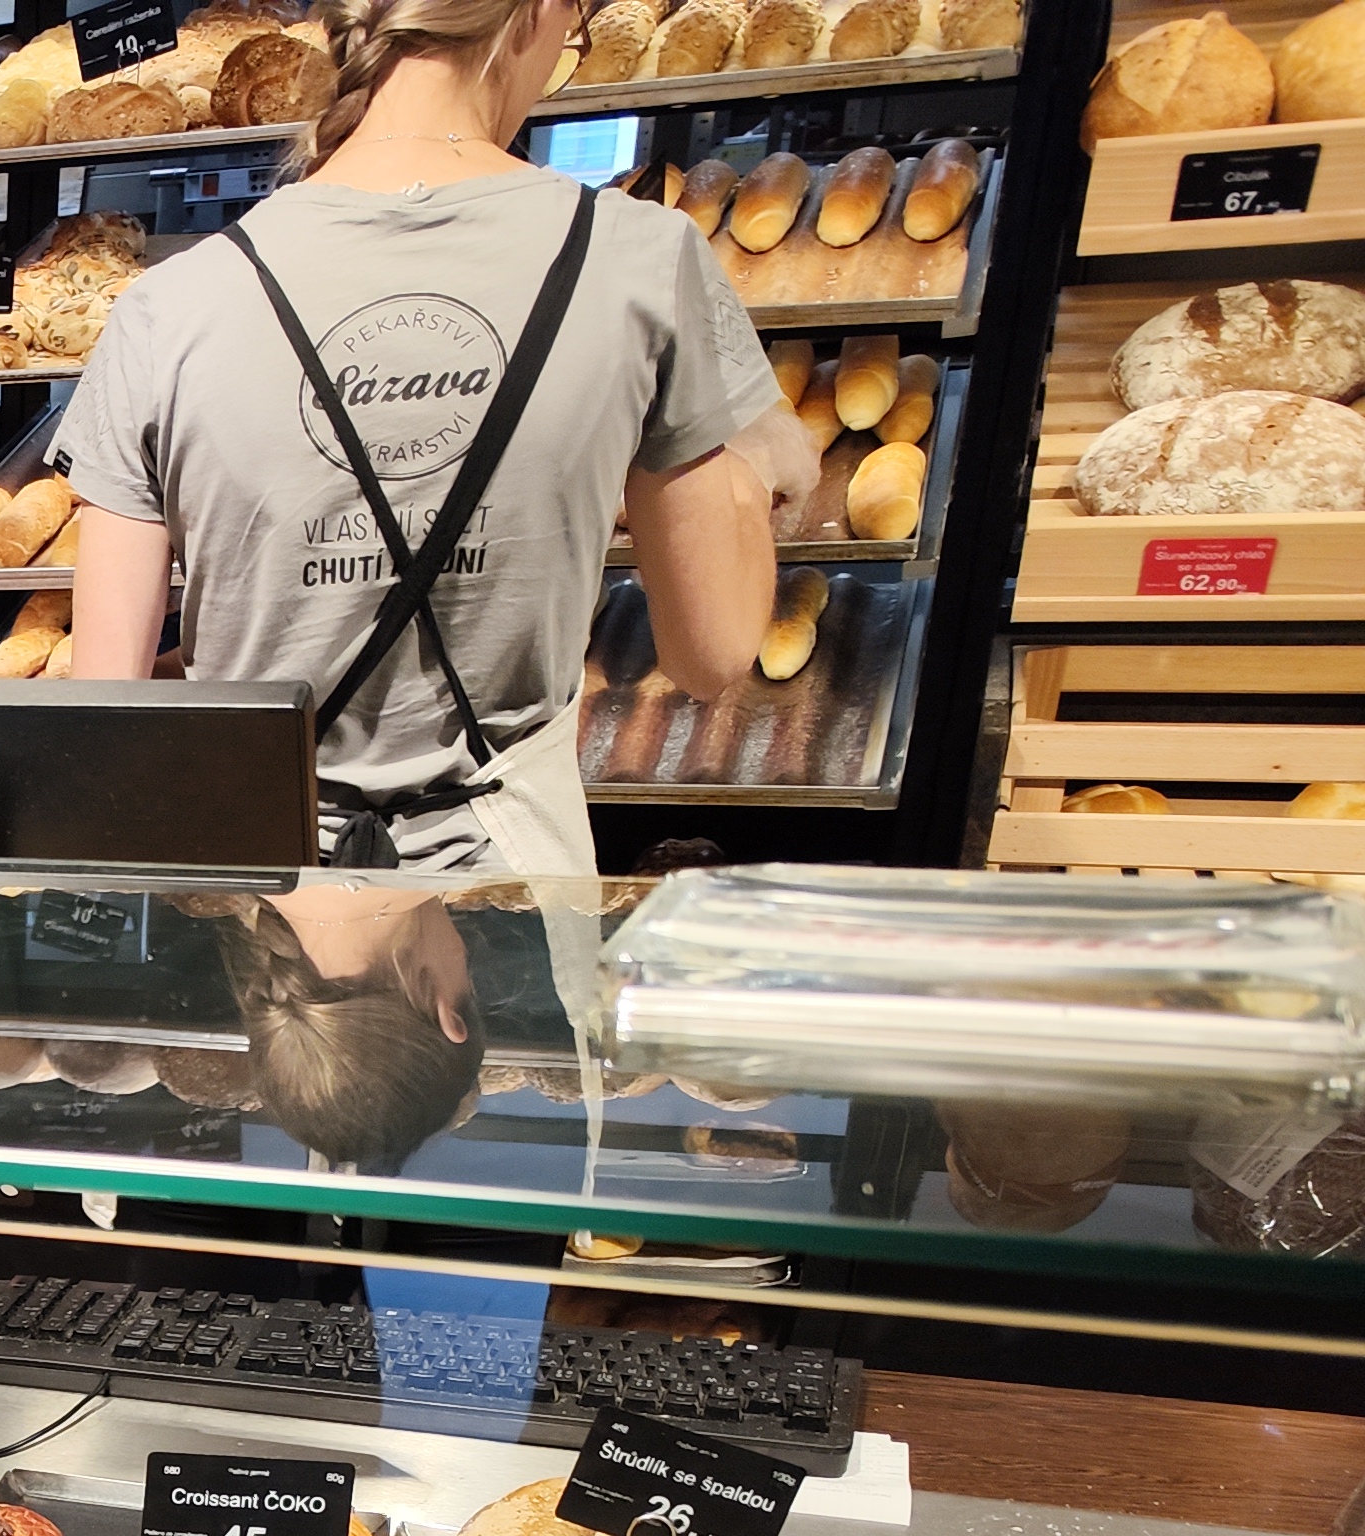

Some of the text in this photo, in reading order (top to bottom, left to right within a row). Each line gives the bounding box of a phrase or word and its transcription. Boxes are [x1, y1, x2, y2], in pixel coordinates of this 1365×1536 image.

[342, 307, 481, 353] PEKAŘSTVÍ
[312, 363, 493, 410] Sázava
[334, 411, 471, 463] KRÁŘSTVÍ
[302, 547, 386, 587] CHUTÍ
[171, 1488, 326, 1513] Croissant ČOKO
[326, 1472, 345, 1484] 80g
[673, 1468, 697, 1487] se
[700, 1475, 777, 1513] špaldou
